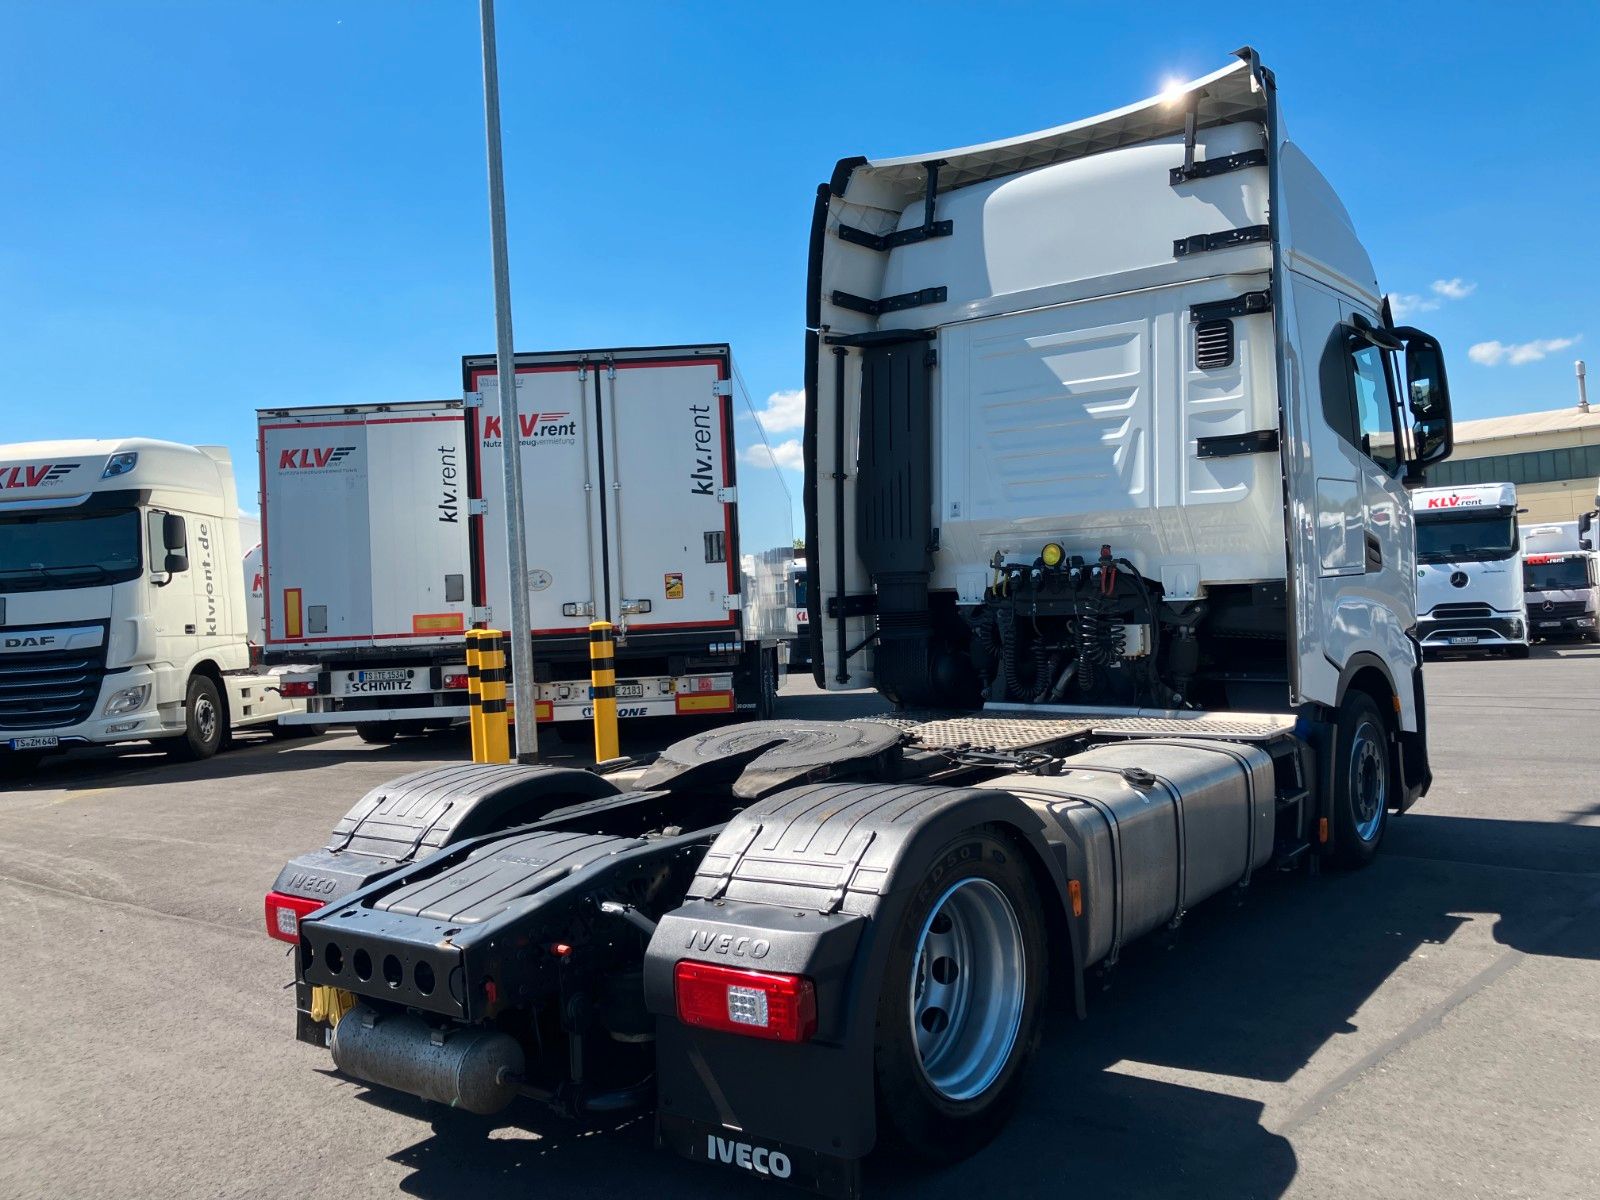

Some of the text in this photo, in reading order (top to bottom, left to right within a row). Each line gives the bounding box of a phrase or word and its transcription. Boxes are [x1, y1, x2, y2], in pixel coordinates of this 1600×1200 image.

[483, 413, 576, 439] KV.rent
[483, 438, 576, 448] Nutzzeugvermietung
[689, 404, 714, 496] klv.rent
[279, 447, 334, 469] KLV
[438, 446, 458, 523] klv.rent
[1428, 495, 1483, 508] KLV.rent
[198, 523, 217, 636] klvrent.de
[5, 636, 55, 648] DAF
[352, 681, 412, 692] SCHMITZ
[365, 671, 373, 680] TS
[287, 872, 337, 895] IVECO
[685, 929, 771, 960] IVECO
[708, 1134, 791, 1179] IVECO
